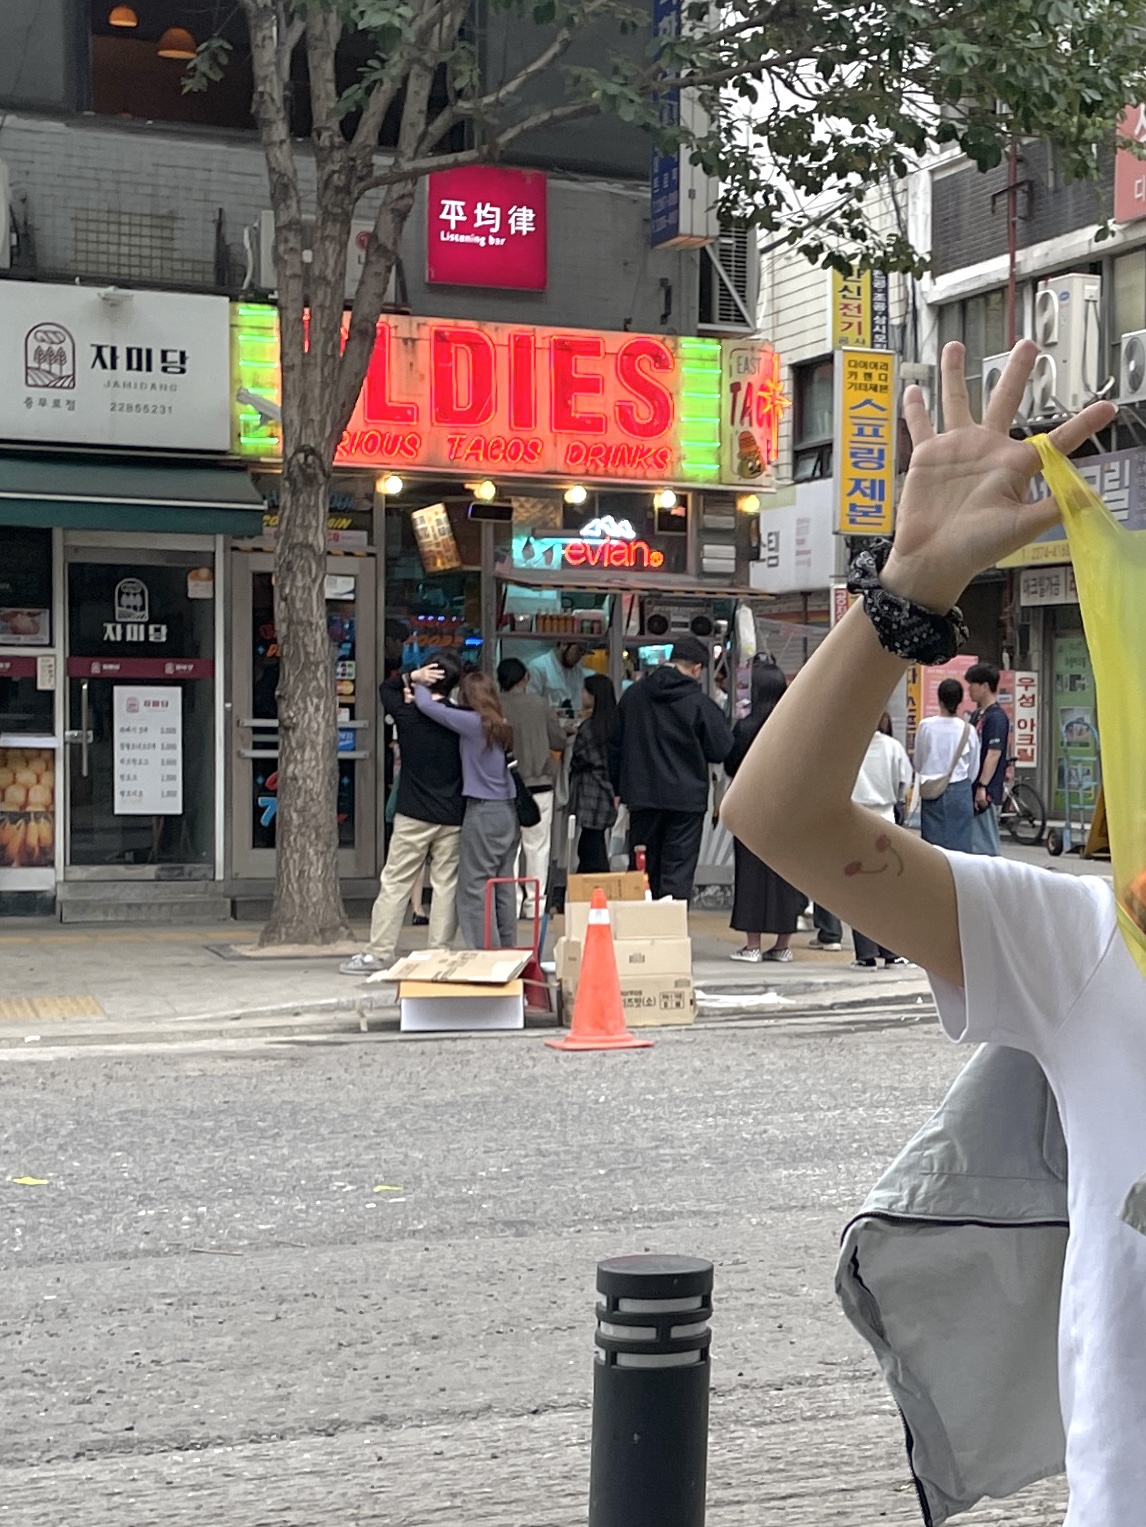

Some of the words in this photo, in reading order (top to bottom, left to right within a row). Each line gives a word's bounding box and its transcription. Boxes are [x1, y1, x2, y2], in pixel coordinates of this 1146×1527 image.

[438, 199, 536, 236] 平均律
[440, 230, 486, 247] Listening
[488, 234, 506, 246] bar
[90, 343, 189, 375] 자미당
[736, 355, 762, 376] EAST
[103, 380, 178, 392] JAMIDANG
[363, 319, 674, 441] LDIES
[336, 429, 423, 460] RIOUS
[447, 434, 545, 464] TACOS
[565, 440, 674, 473] DRINKS
[563, 535, 651, 568] evian
[103, 622, 168, 643] 자미당
